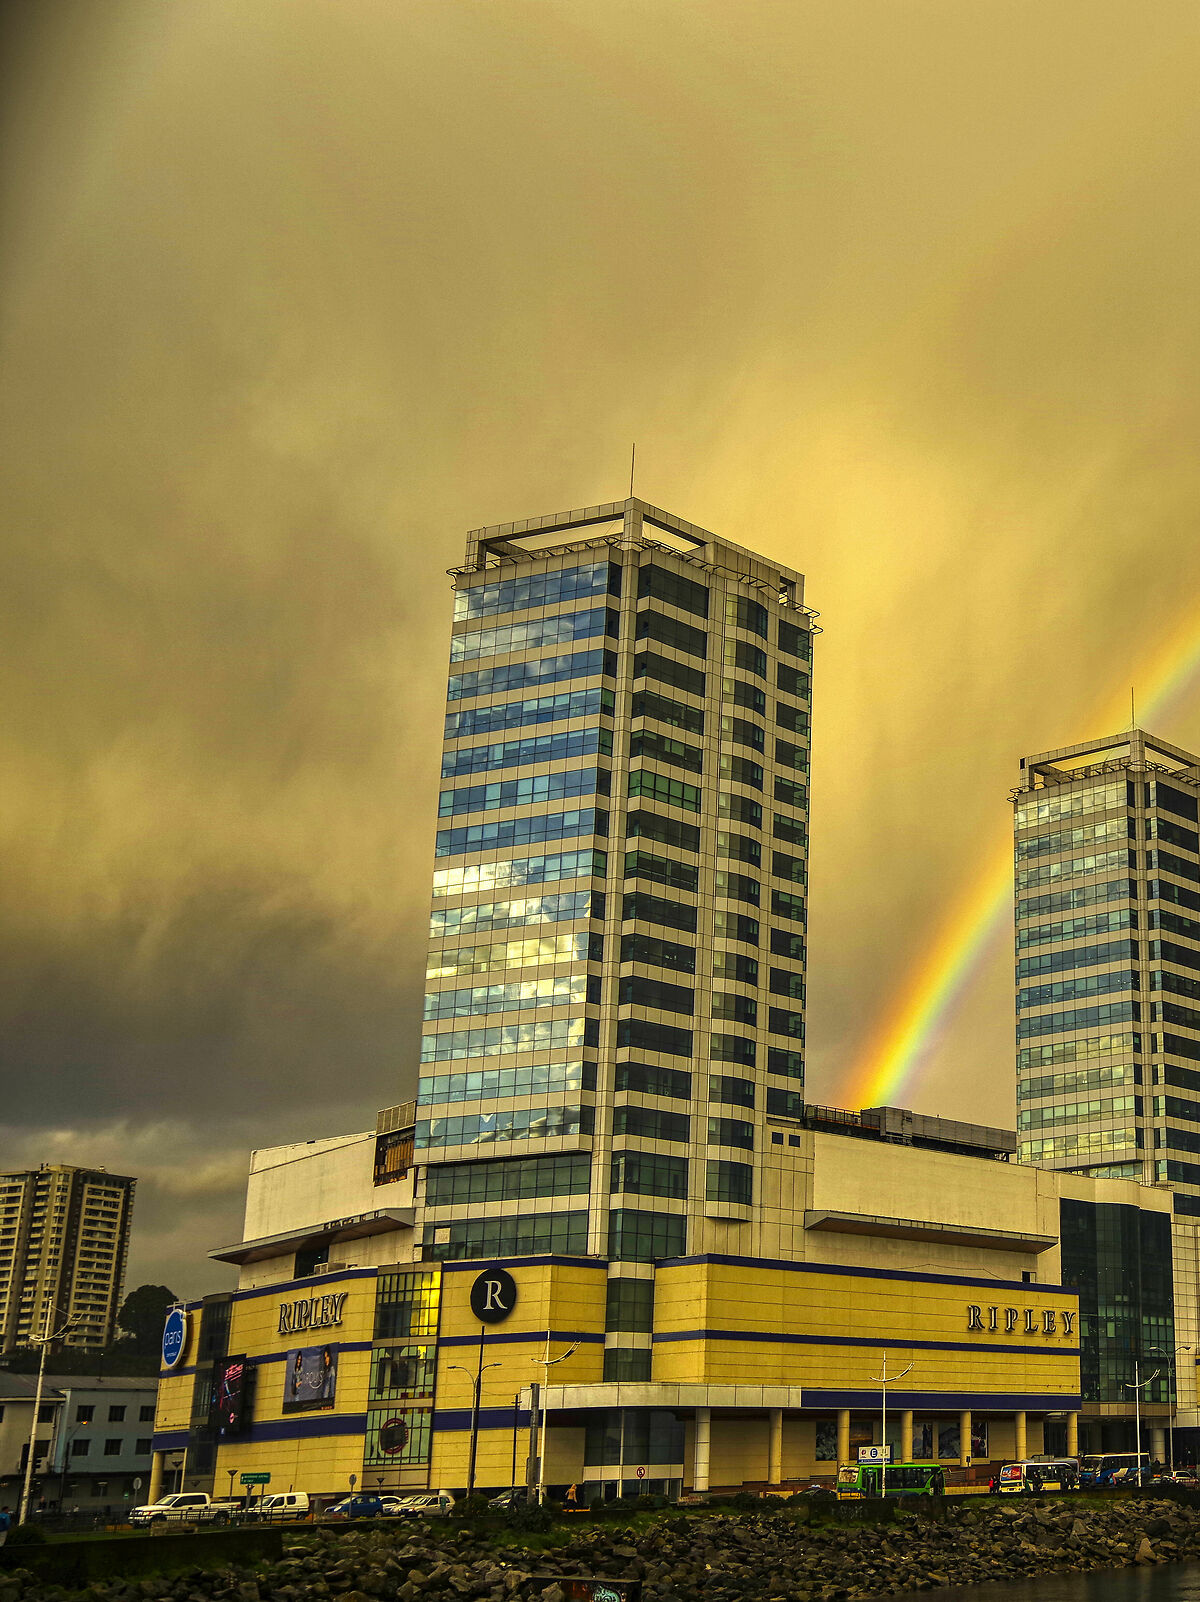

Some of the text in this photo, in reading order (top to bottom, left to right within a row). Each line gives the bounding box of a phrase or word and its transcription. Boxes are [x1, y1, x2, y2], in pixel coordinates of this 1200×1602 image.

[483, 1281, 508, 1310] R
[277, 1292, 348, 1334] RIPLEY
[968, 1305, 1076, 1334] RIPLEY
[165, 1330, 181, 1349] paris
